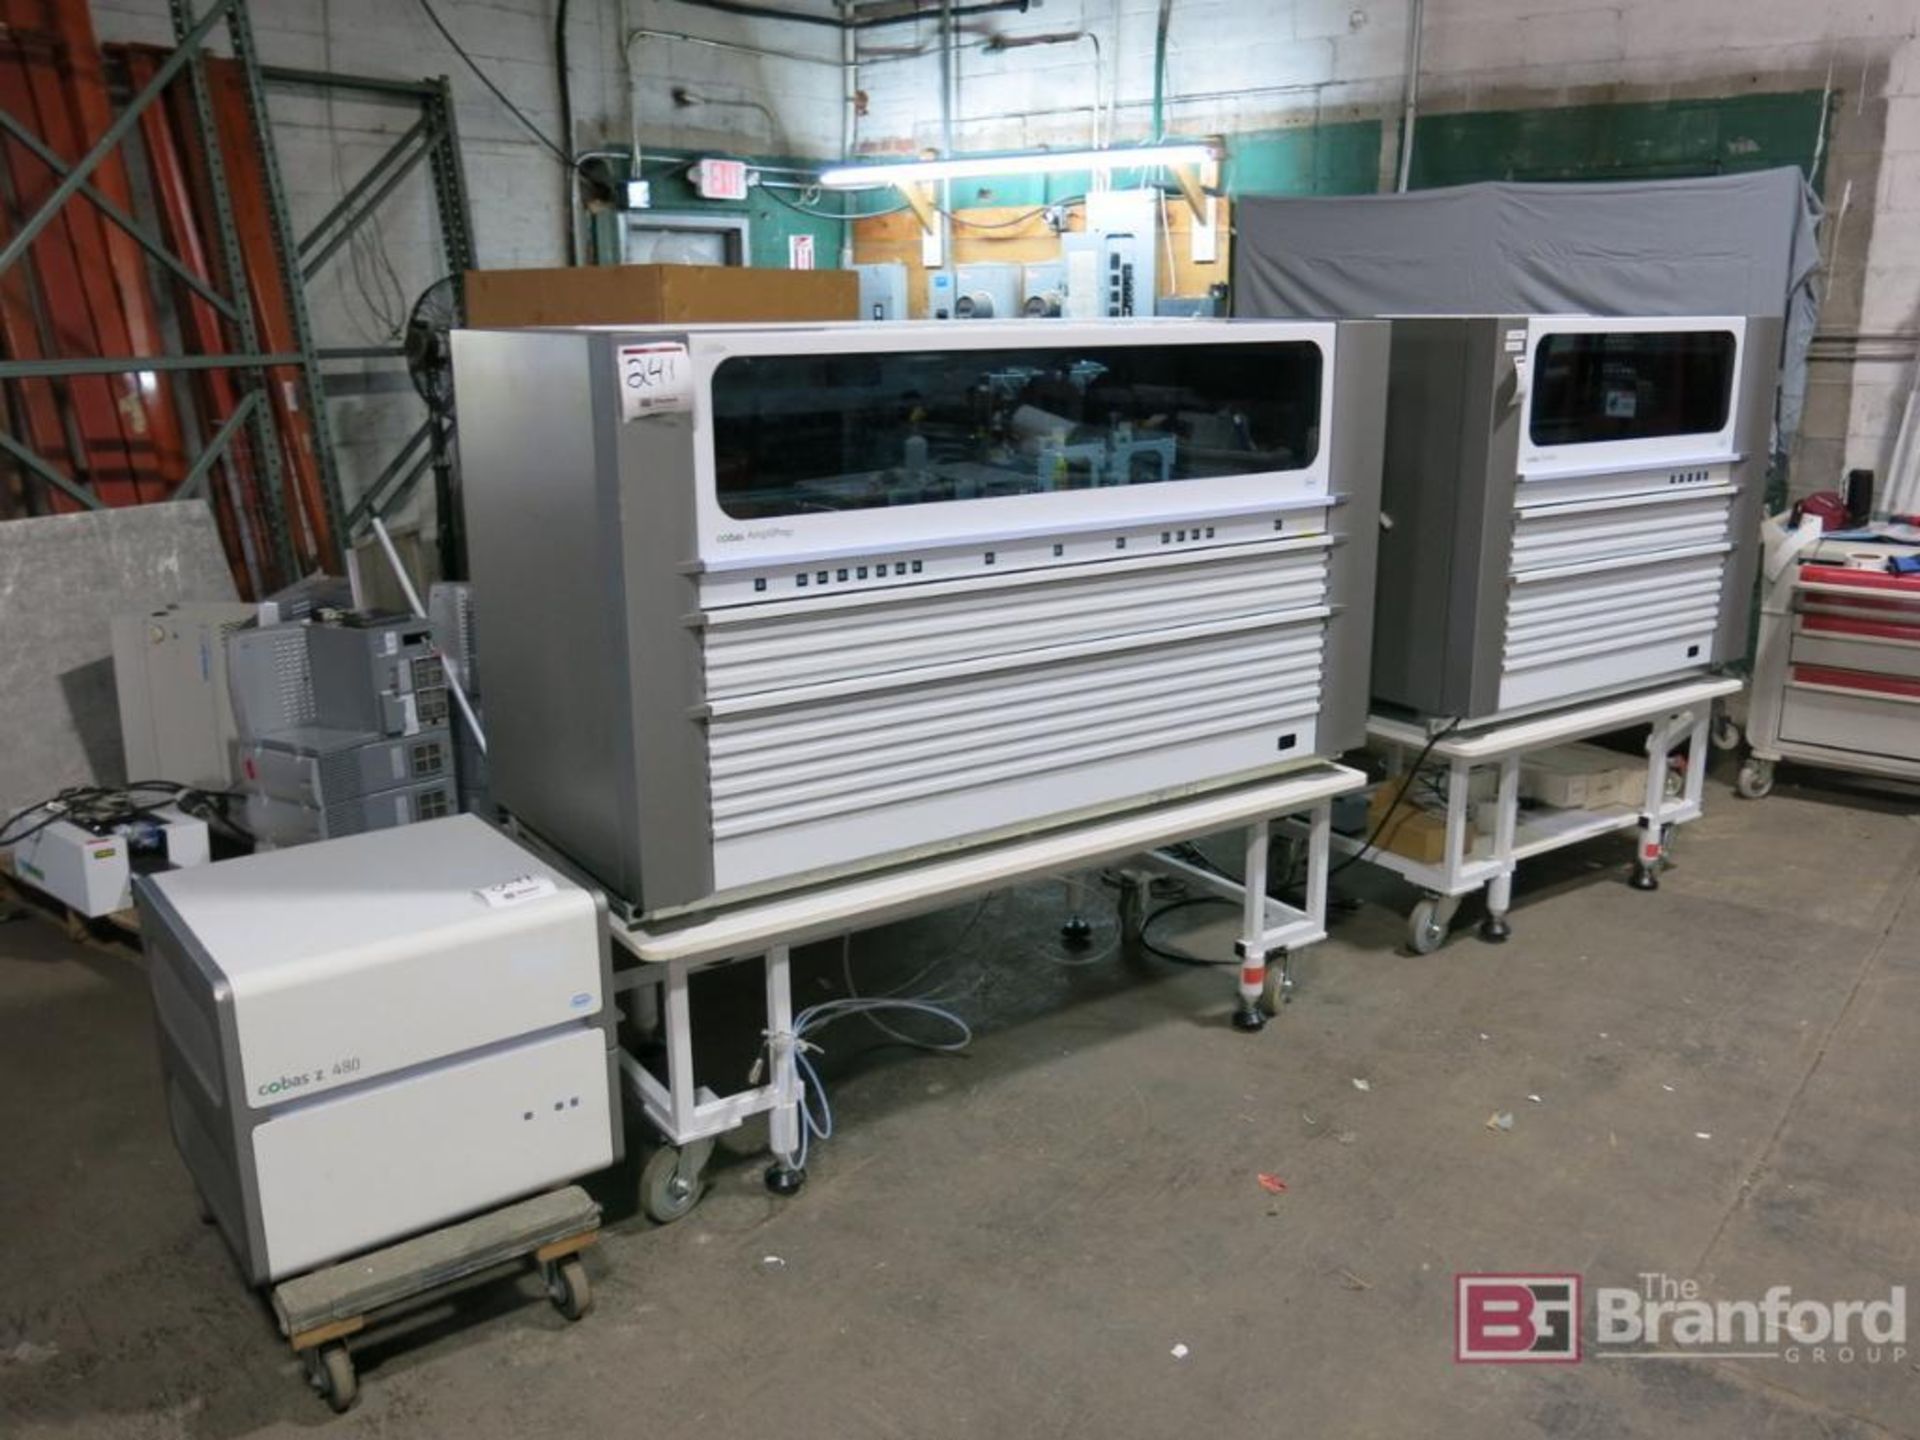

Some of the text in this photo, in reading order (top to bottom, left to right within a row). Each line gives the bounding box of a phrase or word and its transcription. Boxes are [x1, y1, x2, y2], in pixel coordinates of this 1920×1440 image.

[627, 357, 675, 389] 241
[258, 1056, 361, 1096] cobas z 480
